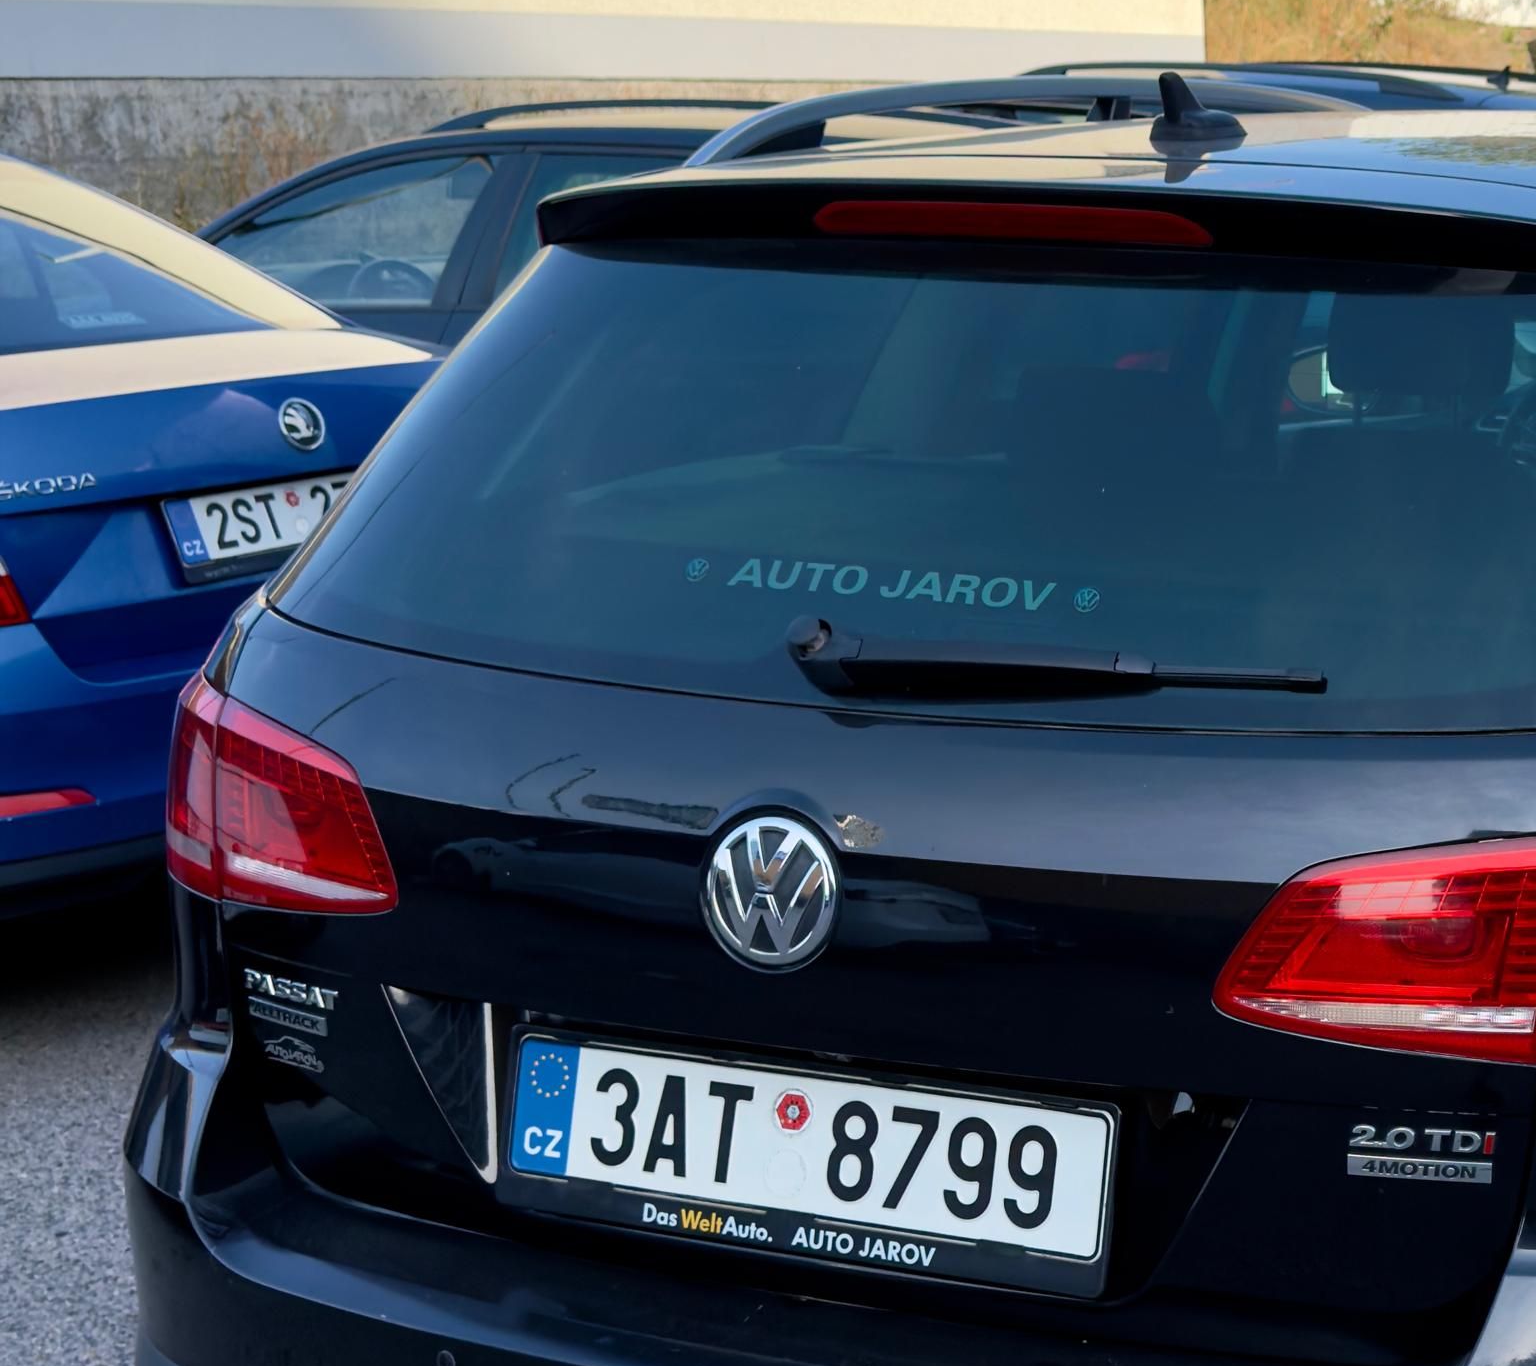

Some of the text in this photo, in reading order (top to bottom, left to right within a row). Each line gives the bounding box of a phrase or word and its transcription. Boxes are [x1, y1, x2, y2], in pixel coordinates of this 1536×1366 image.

[206, 480, 347, 551] 2ST 2
[183, 539, 204, 556] CZ
[727, 558, 869, 596] AUTO
[879, 570, 1058, 612] JAROV
[244, 968, 339, 1011] PASSAT
[523, 1125, 562, 1159] CZ
[590, 1067, 1058, 1230] 3AT 8799
[1349, 1124, 1497, 1155] 2.0 TDI
[1361, 1159, 1477, 1179] 4MOTION
[642, 1202, 678, 1228] Das
[791, 1226, 936, 1267] AUTO JAROV
